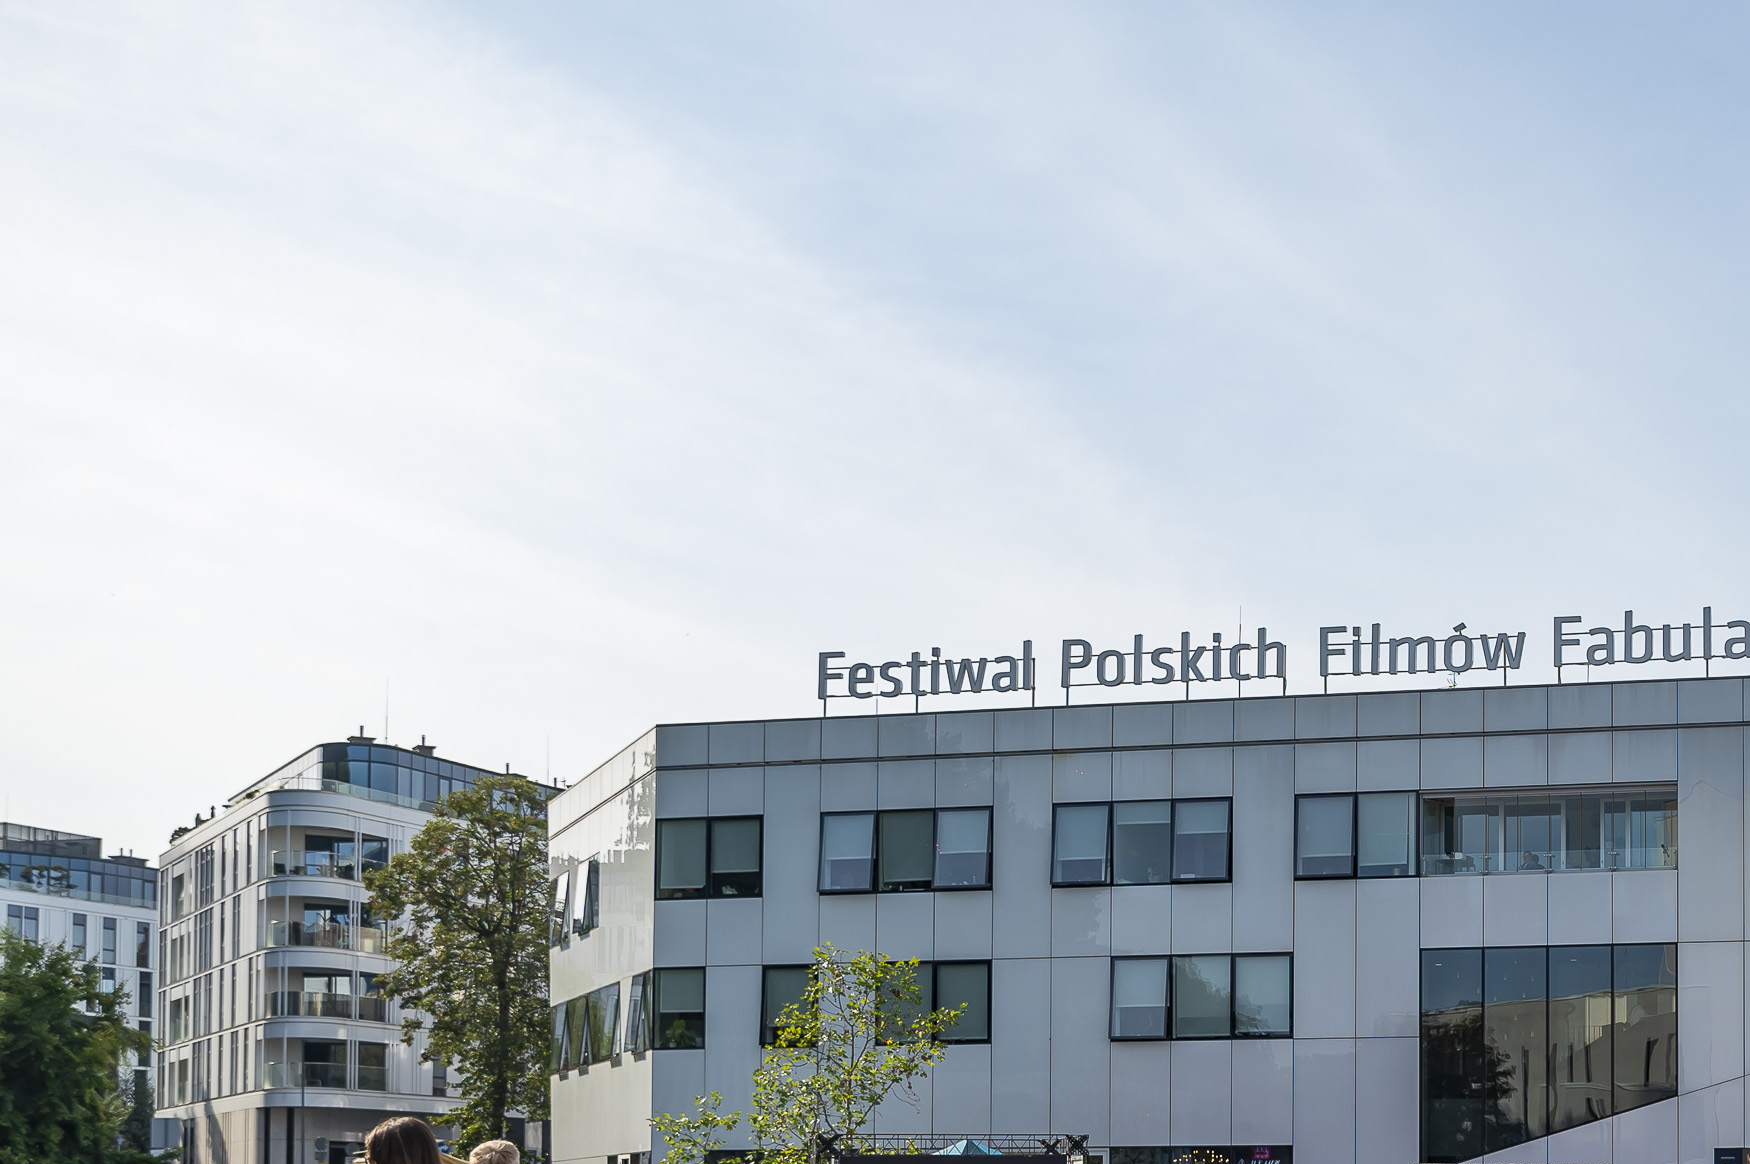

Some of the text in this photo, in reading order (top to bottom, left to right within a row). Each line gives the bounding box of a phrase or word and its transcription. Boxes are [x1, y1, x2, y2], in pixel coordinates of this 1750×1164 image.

[818, 640, 1033, 700] Festiwal
[1061, 627, 1286, 688] Polskich
[1319, 622, 1527, 676] Filmów
